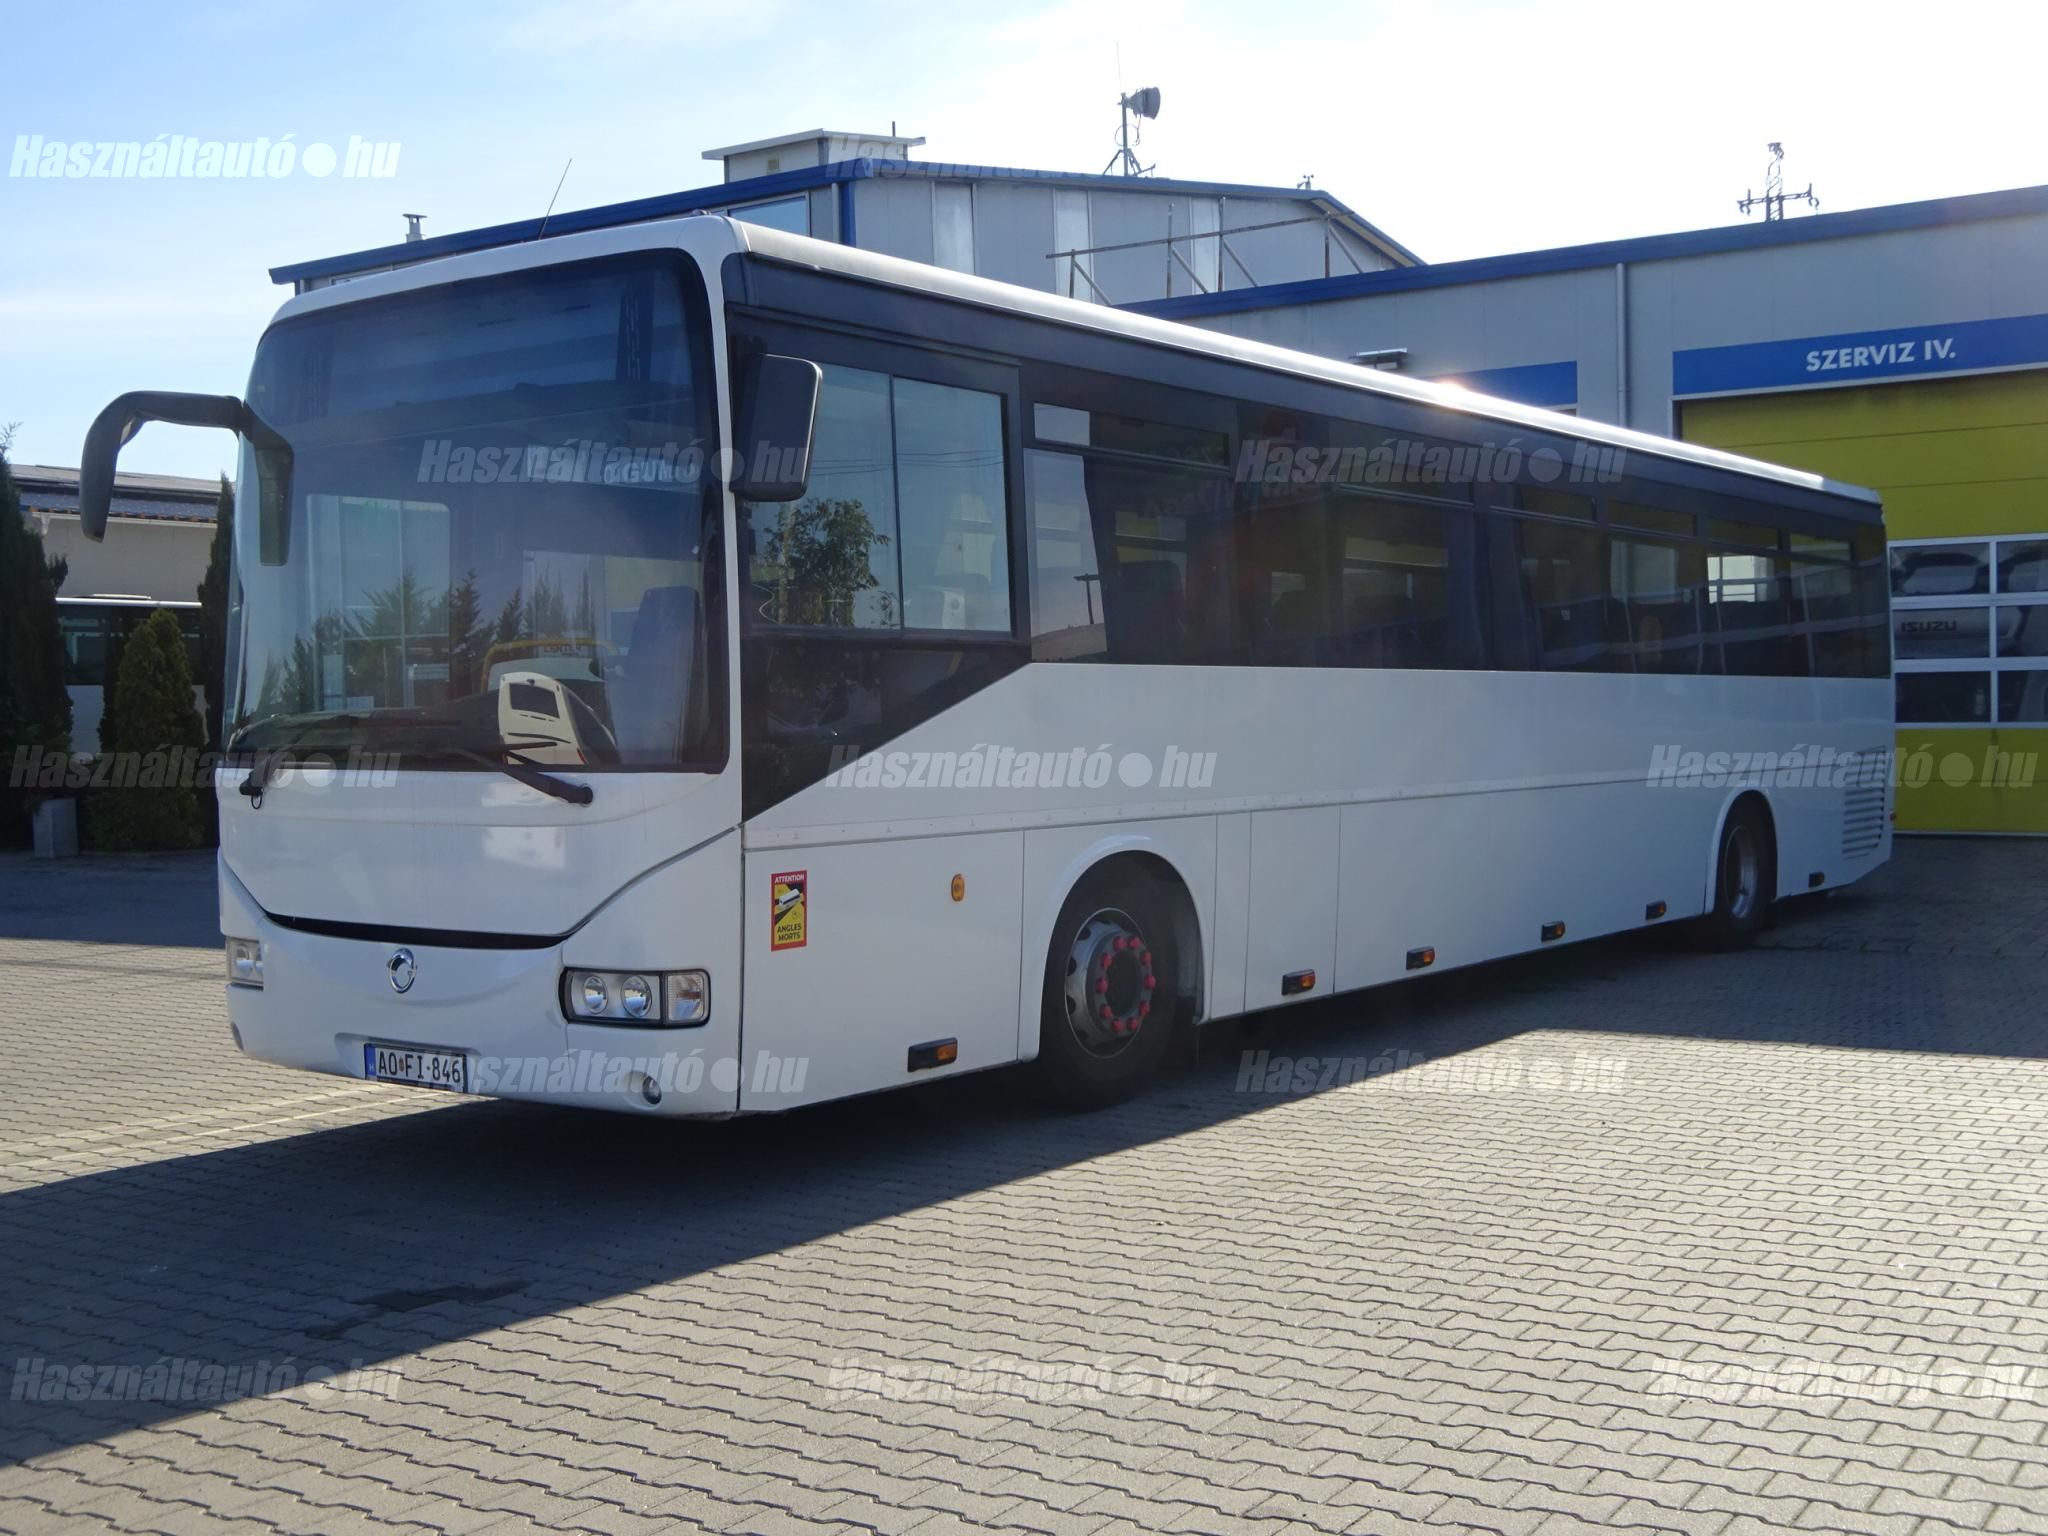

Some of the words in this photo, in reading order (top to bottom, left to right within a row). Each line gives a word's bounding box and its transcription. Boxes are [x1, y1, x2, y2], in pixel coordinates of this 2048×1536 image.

[1805, 341, 1915, 372] SZERVIZ
[1924, 337, 1956, 361] IV.
[774, 874, 805, 883] ATTENTION
[777, 923, 802, 933] ANGLES
[778, 932, 801, 942] MORTS
